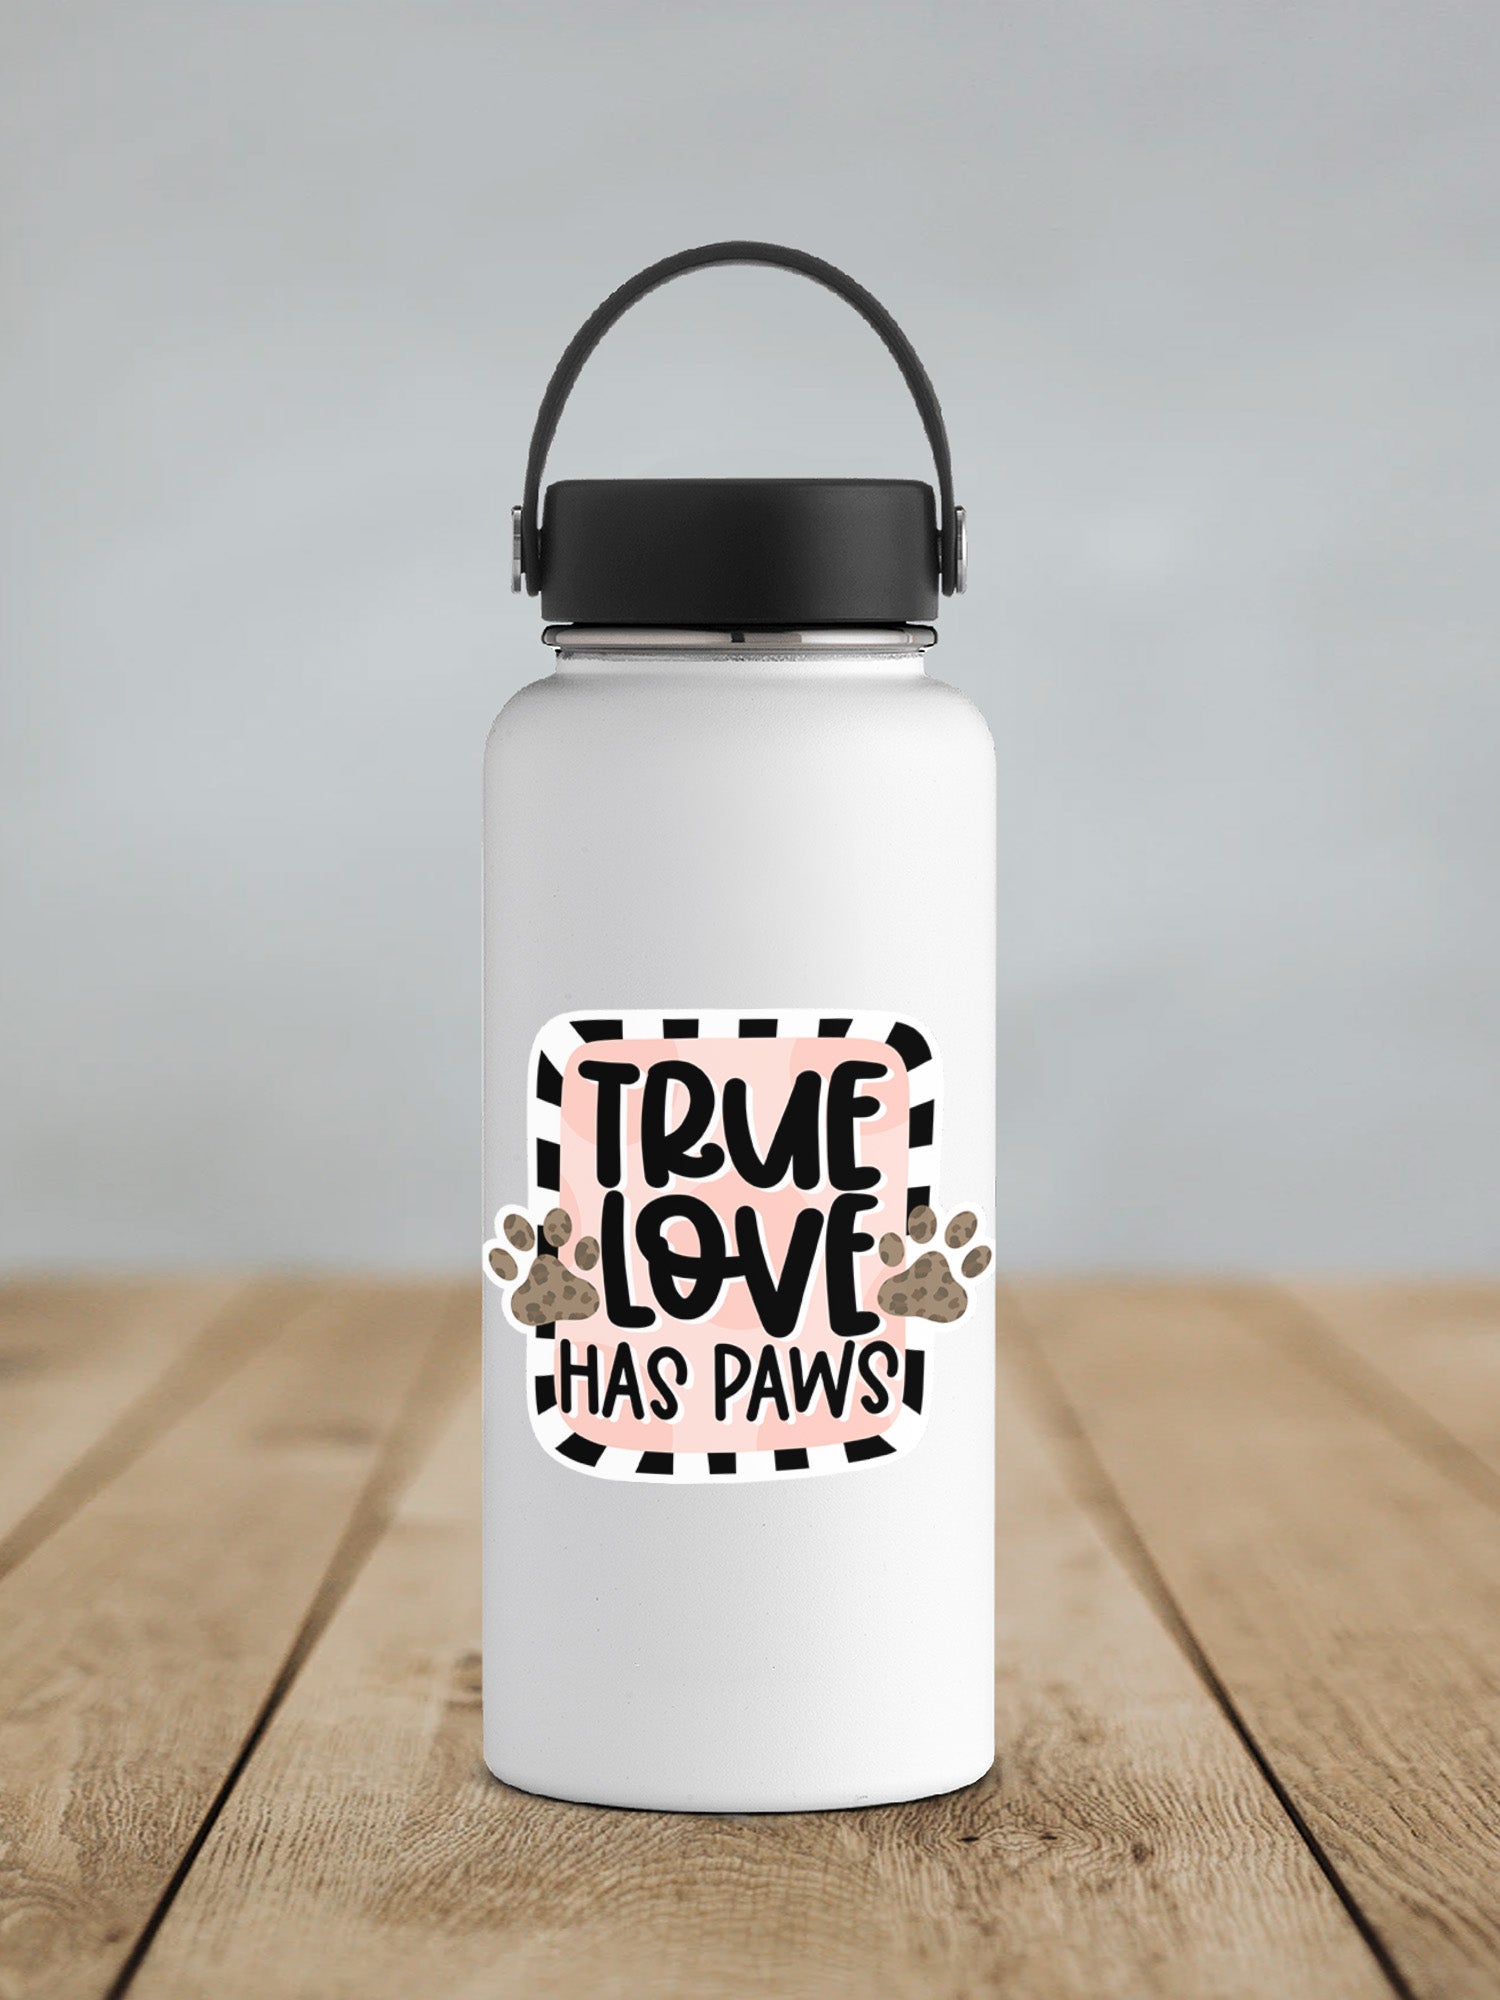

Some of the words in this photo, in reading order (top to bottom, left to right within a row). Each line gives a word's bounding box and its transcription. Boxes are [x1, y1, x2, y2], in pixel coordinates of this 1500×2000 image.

[577, 1060, 888, 1192] TRUE
[601, 1190, 880, 1338] LOVE
[560, 1338, 688, 1420] HAS
[714, 1340, 899, 1422] PAWS
